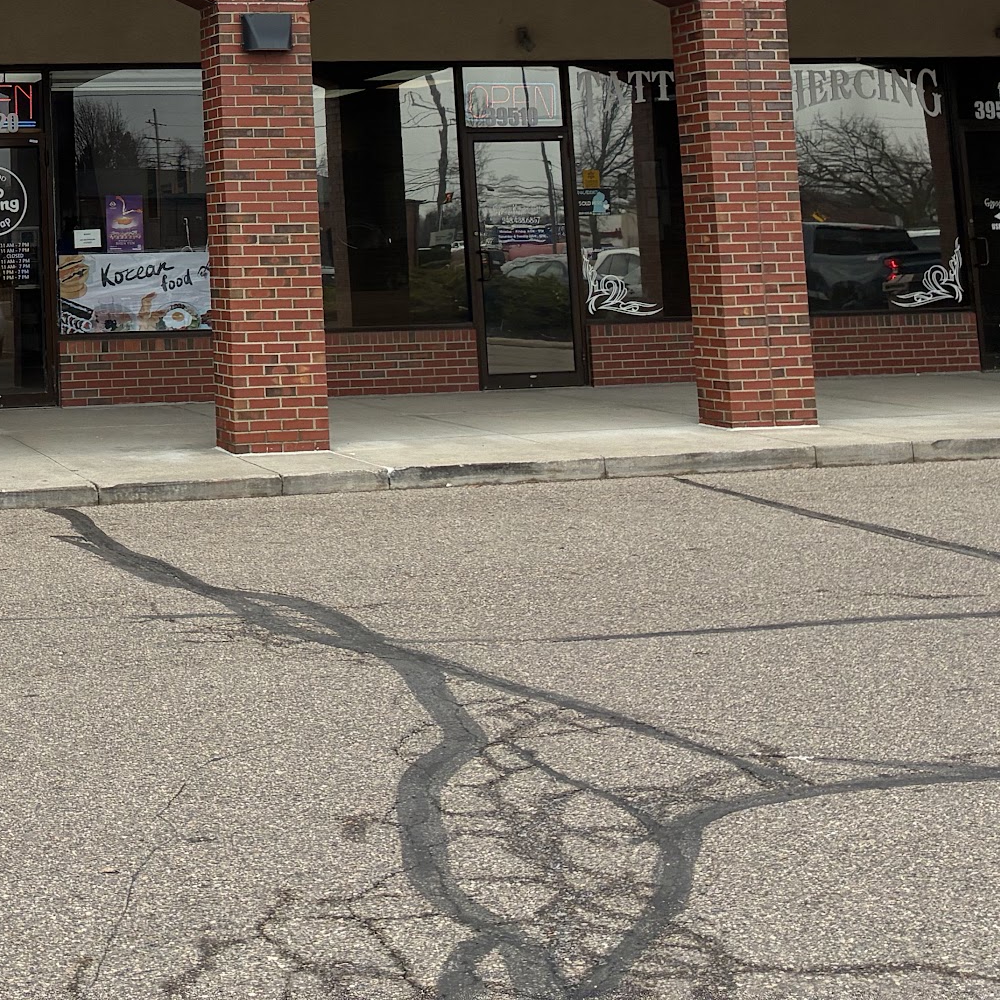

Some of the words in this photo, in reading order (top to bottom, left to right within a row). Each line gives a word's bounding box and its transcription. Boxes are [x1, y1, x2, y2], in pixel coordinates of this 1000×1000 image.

[469, 85, 554, 119] OPEN
[485, 107, 539, 126] 39510
[161, 268, 193, 292] food
